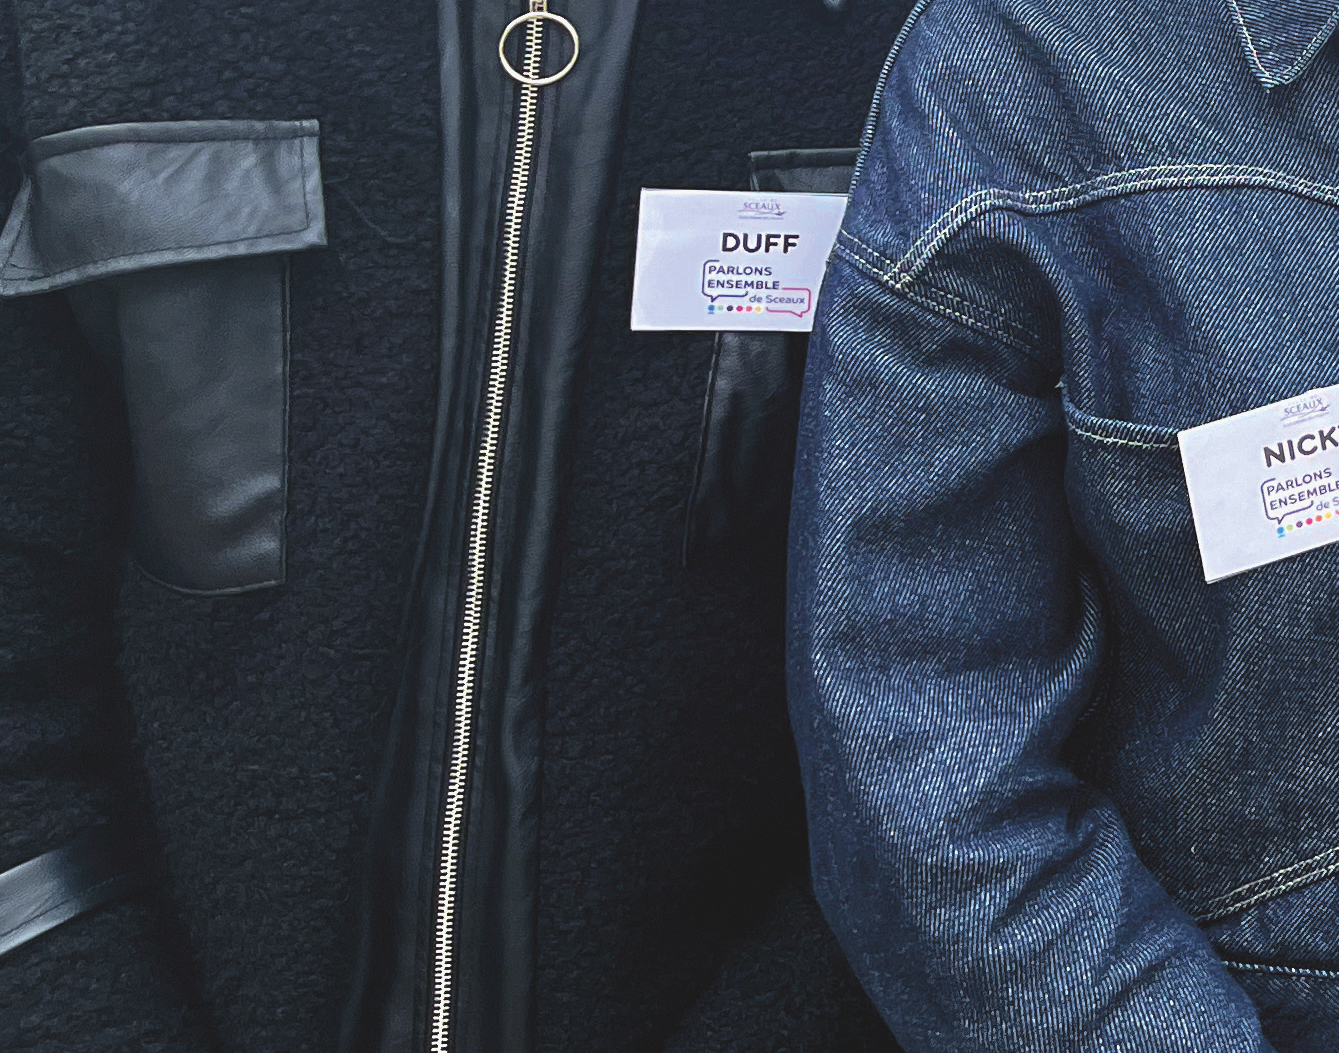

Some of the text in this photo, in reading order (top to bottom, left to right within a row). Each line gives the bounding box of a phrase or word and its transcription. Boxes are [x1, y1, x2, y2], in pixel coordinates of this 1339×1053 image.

[721, 232, 800, 254] DUFF
[708, 265, 773, 276] PARLONS
[707, 279, 780, 290] ENSEMBLE
[749, 294, 805, 304] de Sceaux
[1266, 467, 1333, 496] PARLONS
[1316, 499, 1330, 511] de
